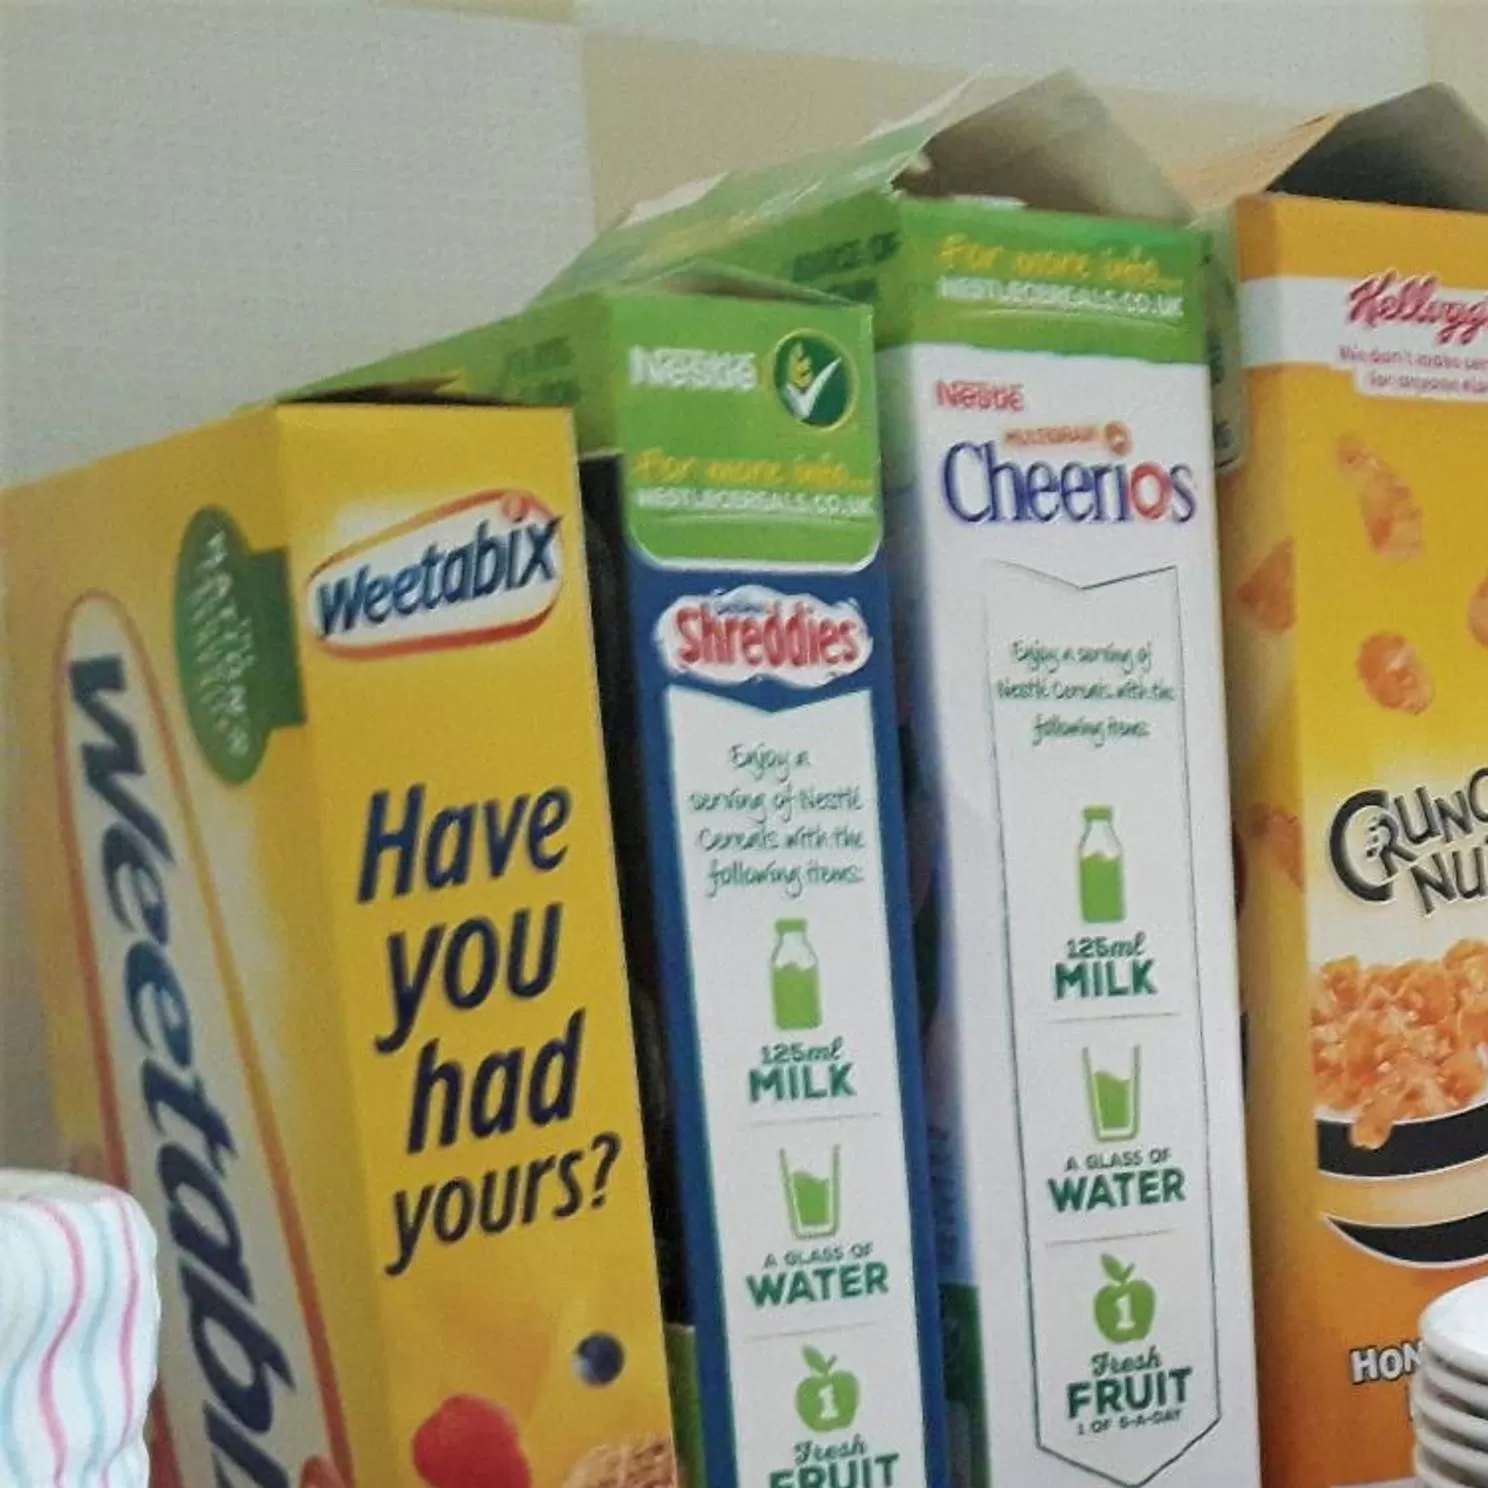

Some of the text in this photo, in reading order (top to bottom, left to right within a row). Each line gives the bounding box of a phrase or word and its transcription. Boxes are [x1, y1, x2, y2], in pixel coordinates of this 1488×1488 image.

[943, 440, 1198, 523] Cheerios
[316, 508, 562, 638] Weetabix
[676, 603, 858, 667] Shreddies
[1011, 639, 1060, 674] Enjoy
[1078, 641, 1135, 675] serving
[1137, 640, 1153, 674] of
[1032, 713, 1105, 748] following
[729, 743, 812, 782] Enjoy a
[689, 788, 767, 824] serving
[774, 784, 795, 823] of
[356, 783, 571, 903] Have
[699, 825, 865, 851] Cereals with the
[707, 860, 804, 899] following
[1066, 930, 1147, 959] 125ml
[375, 903, 563, 1053] you
[1055, 957, 1158, 1001] MILK
[761, 1036, 844, 1064] 125ml
[406, 1008, 587, 1153] had
[748, 1063, 857, 1102] MILK
[1065, 1147, 1172, 1171] A GLASS OF
[384, 1131, 621, 1276] yours?
[1047, 1166, 1187, 1213] WATER
[763, 1242, 874, 1269] A GLASS OF
[746, 1261, 889, 1309] WATER
[1114, 1291, 1137, 1331] 1
[1090, 1344, 1162, 1378] Fresh
[817, 1383, 839, 1420] 1
[1066, 1365, 1194, 1419] FRUIT
[1091, 1418, 1113, 1434] OF
[794, 1434, 867, 1465] Fresh
